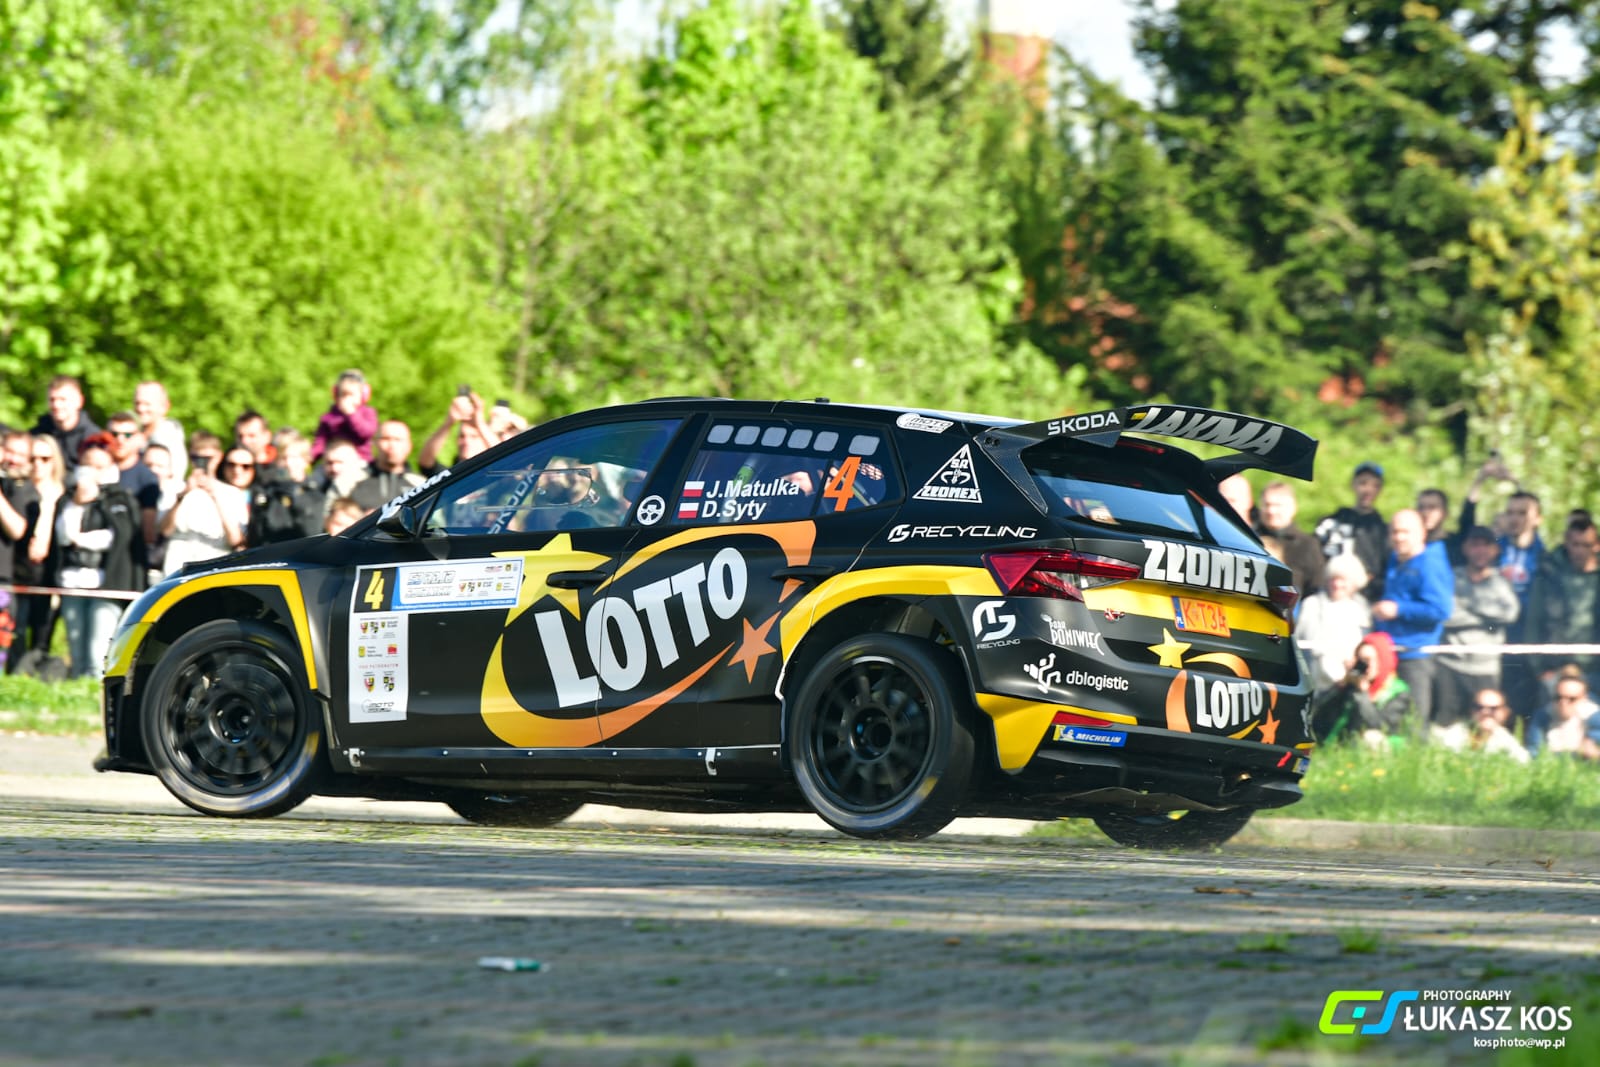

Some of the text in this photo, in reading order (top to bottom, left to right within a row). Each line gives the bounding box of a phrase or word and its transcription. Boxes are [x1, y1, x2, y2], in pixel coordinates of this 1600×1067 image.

[1047, 411, 1120, 436] SKODA
[1132, 407, 1284, 456] LAKMA
[706, 480, 800, 499] J.Matulka
[823, 456, 862, 512] 4
[702, 499, 767, 521] D.Syty
[911, 525, 1038, 539] RECYCLING
[363, 570, 385, 610] 4
[534, 547, 747, 707] LOTTO
[976, 638, 1022, 650] RECYCLING
[1066, 670, 1129, 692] dblogistic
[1193, 674, 1264, 729] LOTTO
[1075, 732, 1122, 743] MICHELIN
